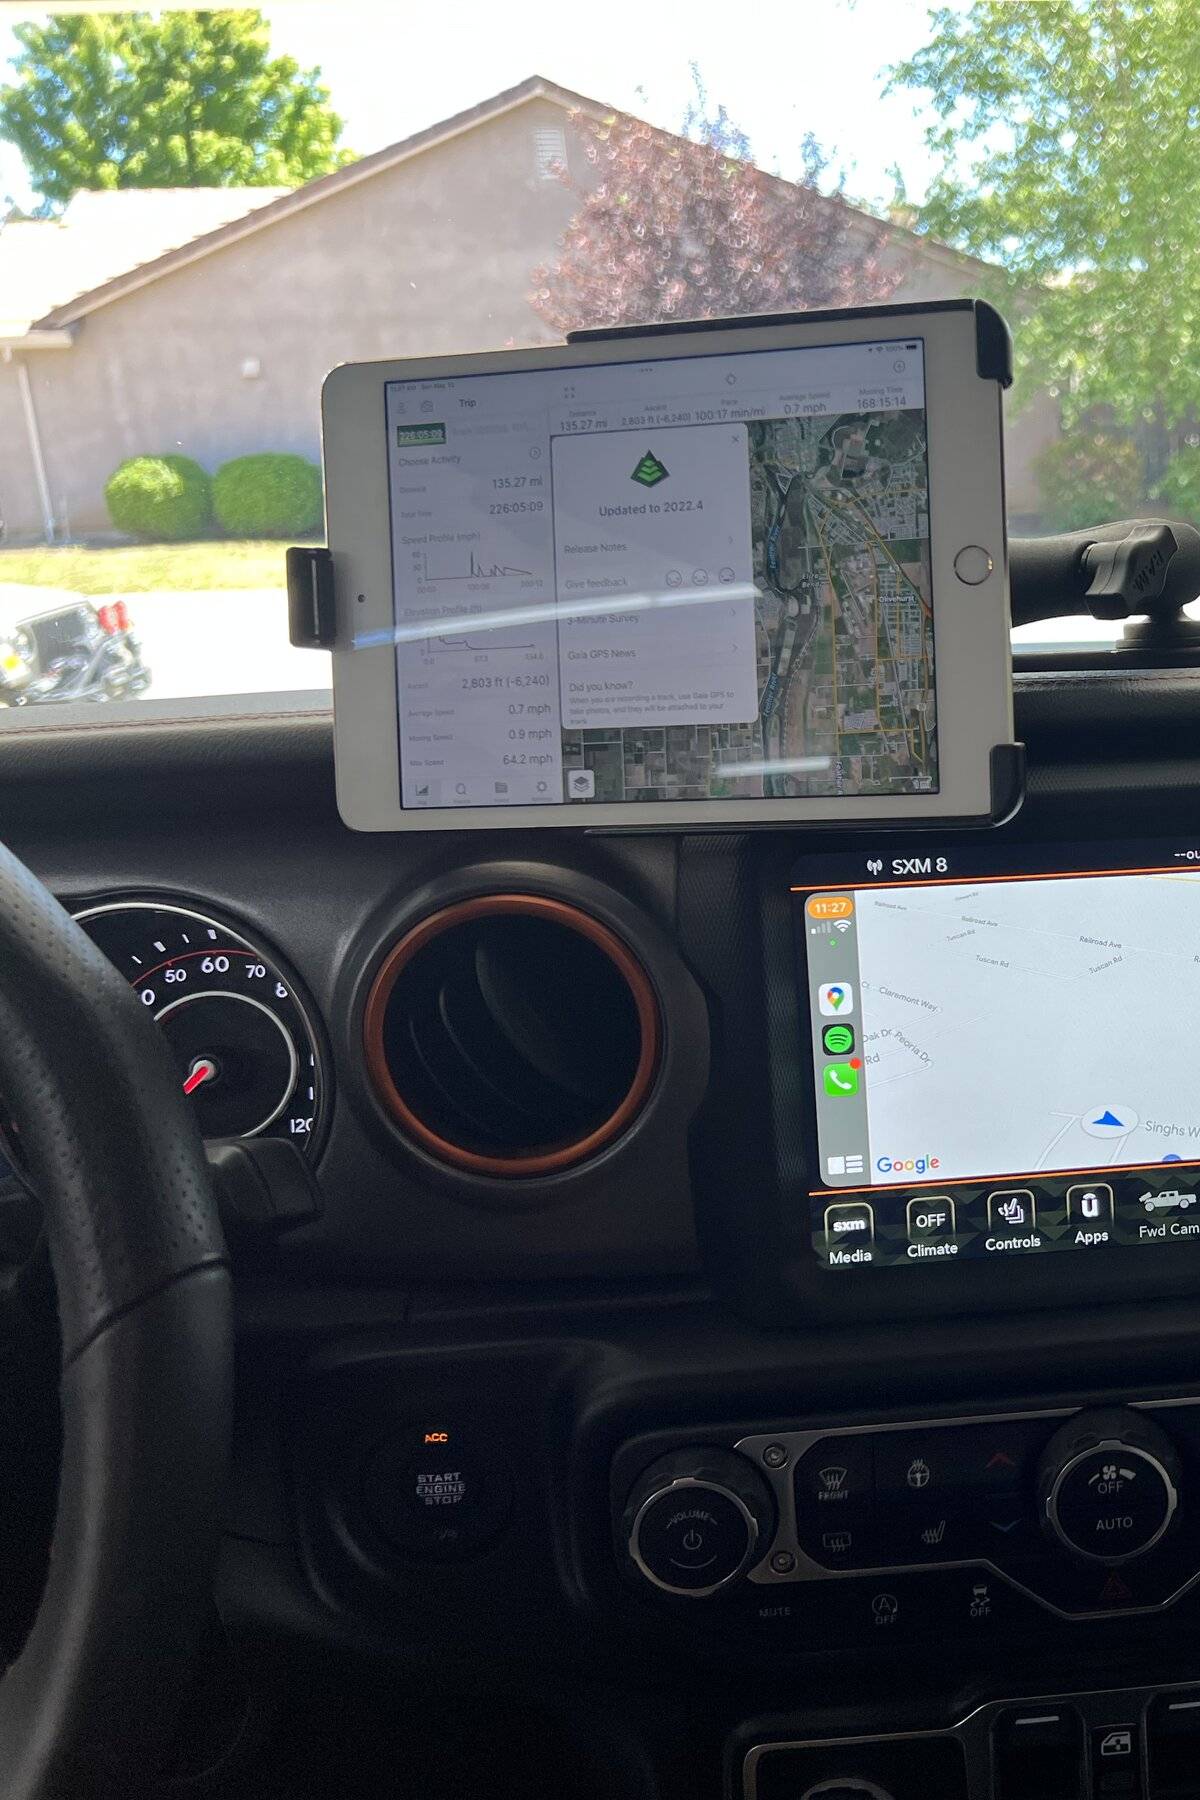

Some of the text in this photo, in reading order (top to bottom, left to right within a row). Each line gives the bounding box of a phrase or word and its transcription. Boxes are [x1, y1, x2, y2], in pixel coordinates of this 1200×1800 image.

[459, 399, 477, 408] Trip
[803, 403, 827, 415] mph
[492, 475, 544, 490] 135.27 mi
[489, 501, 544, 515] 226:05:09
[599, 500, 704, 517] Updated to 2022.4
[563, 542, 628, 554] Release Notes
[587, 683, 603, 694] you
[605, 680, 635, 691] know?
[507, 703, 552, 717] 0.7 mph
[508, 728, 553, 741] 0.9 mph
[503, 752, 554, 768] 64.2 mph
[891, 857, 948, 875] SXM 8
[815, 901, 847, 914] 11:27
[1079, 934, 1123, 950] Railroad Ave
[200, 956, 230, 974] 60
[975, 954, 1010, 969] Tuscan Rd
[1088, 955, 1123, 975] Tuscan Rd
[164, 967, 187, 984] 50
[245, 963, 266, 979] 70
[879, 986, 938, 1013] Claremont Way
[894, 1031, 921, 1056] Peoria
[865, 1052, 880, 1065] Rd
[1144, 1120, 1186, 1138] Singhs
[876, 1153, 940, 1175] Google
[915, 1212, 946, 1229] OFF
[1074, 1229, 1109, 1246] Apps
[1139, 1221, 1200, 1239] Fwd Cam
[985, 1233, 1042, 1251] Controls
[829, 1249, 873, 1265] Media
[907, 1241, 959, 1259] Climate
[424, 1432, 449, 1443] ACC
[417, 1472, 462, 1483] START
[416, 1483, 467, 1495] ENGINE
[1097, 1480, 1124, 1495] OFF
[424, 1495, 463, 1506] STOP
[1096, 1516, 1133, 1531] AUTO
[759, 1606, 792, 1618] MUTE
[969, 1606, 992, 1617] OFF
[874, 1614, 898, 1625] OFF
